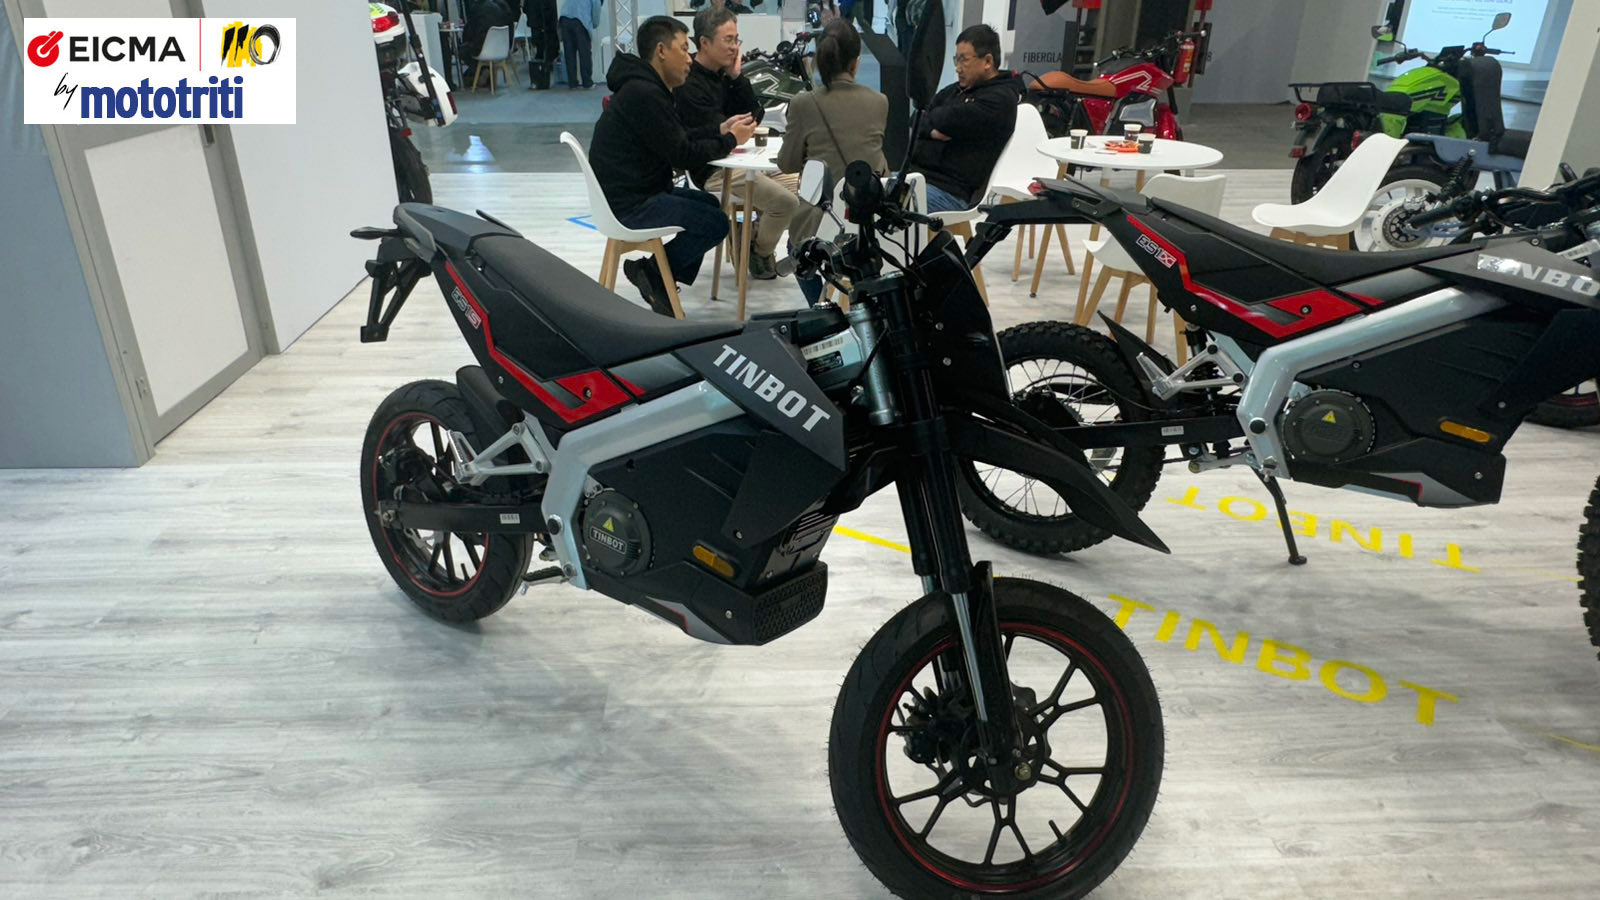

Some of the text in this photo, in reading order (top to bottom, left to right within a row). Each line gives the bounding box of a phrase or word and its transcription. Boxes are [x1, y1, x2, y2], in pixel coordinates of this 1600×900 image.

[712, 344, 831, 432] TINBOT
[592, 529, 625, 550] TINBOT
[1107, 593, 1459, 727] TINBOT
